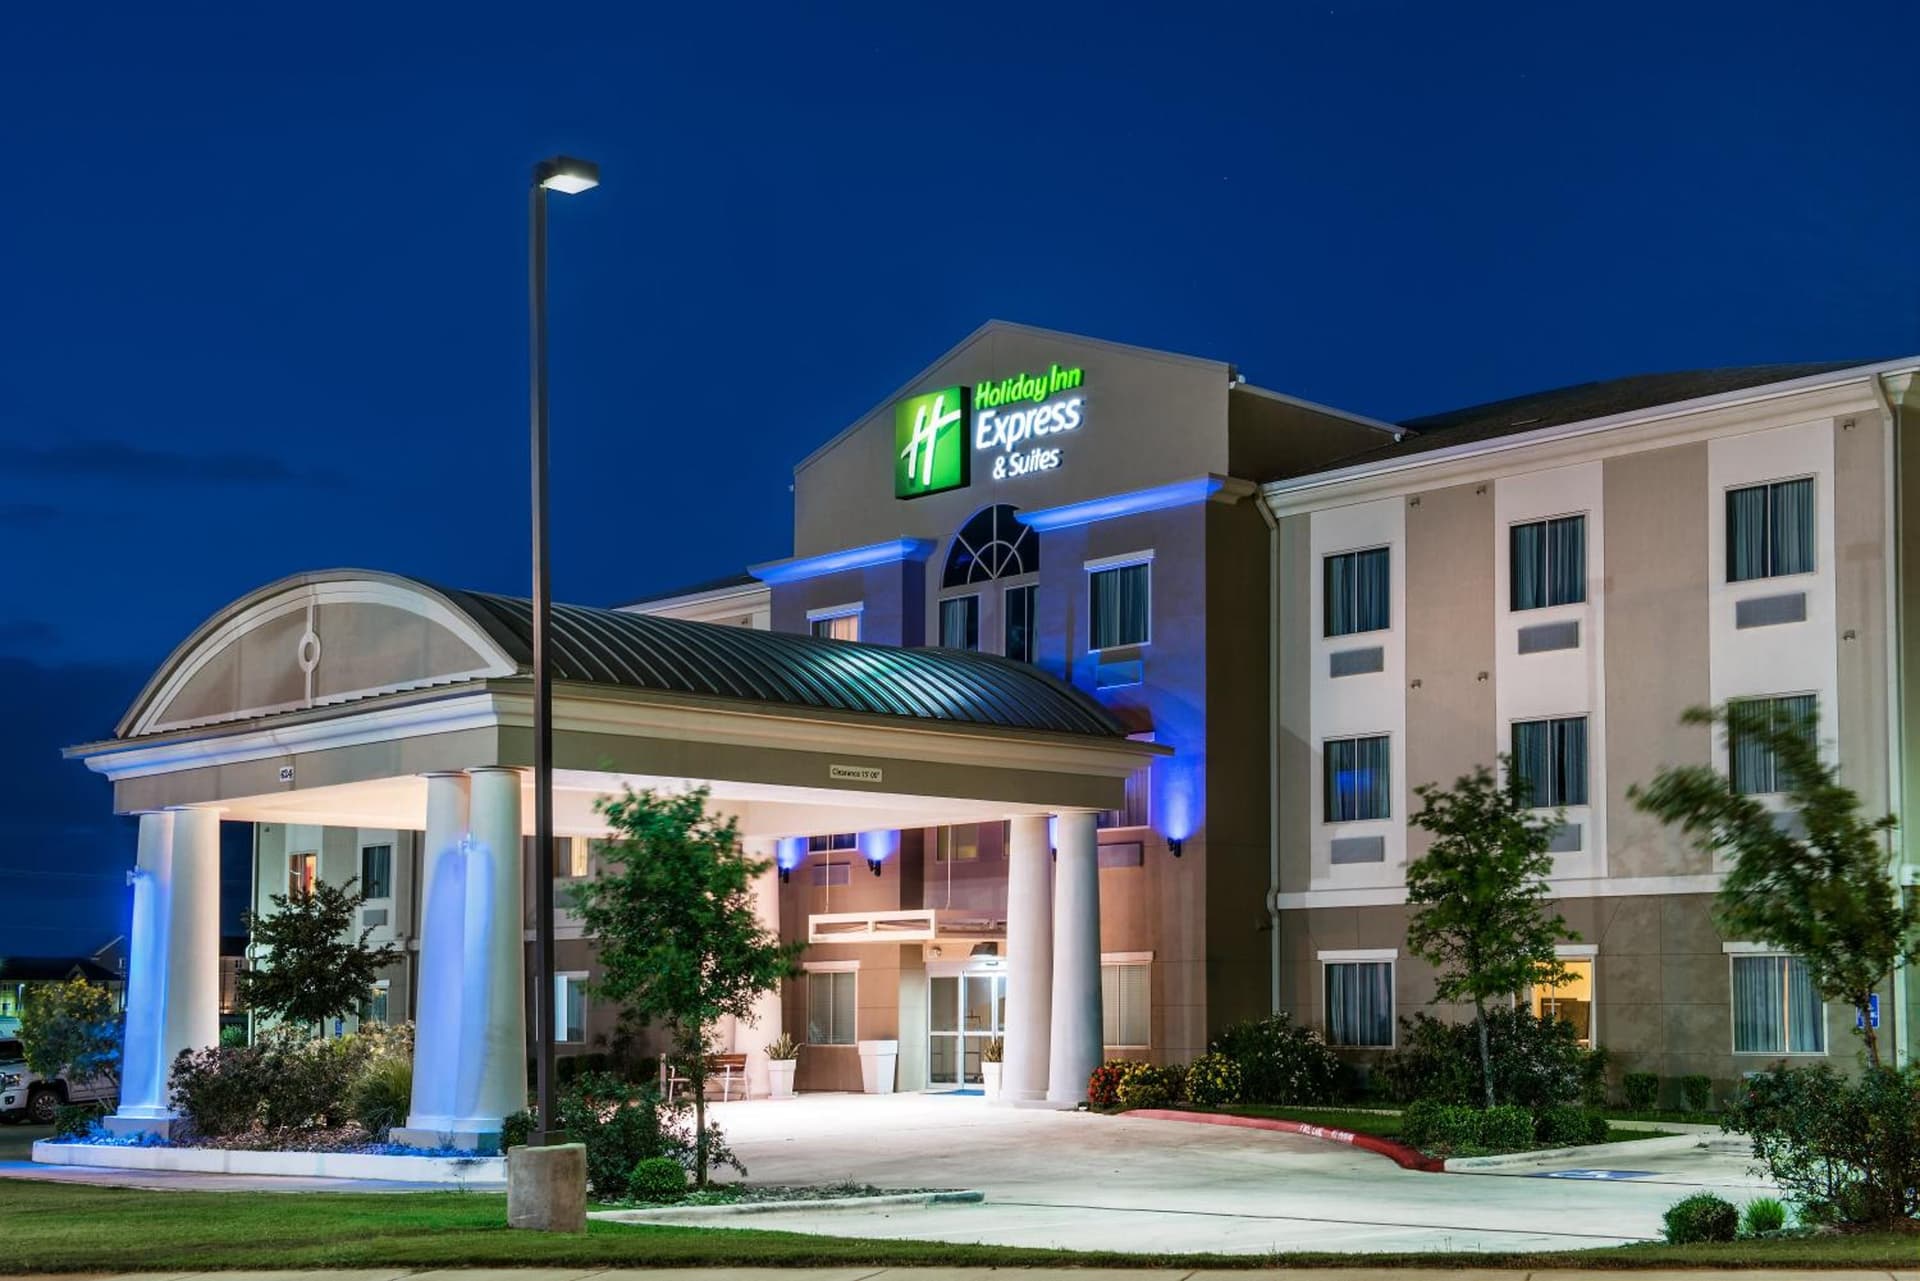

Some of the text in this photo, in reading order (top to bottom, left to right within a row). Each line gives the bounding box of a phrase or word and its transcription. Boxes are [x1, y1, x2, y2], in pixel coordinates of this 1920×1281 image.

[975, 364, 1083, 409] Holiday Inn
[975, 397, 1082, 452] Express
[992, 447, 1061, 480] & Suites
[832, 767, 860, 777] Clearance
